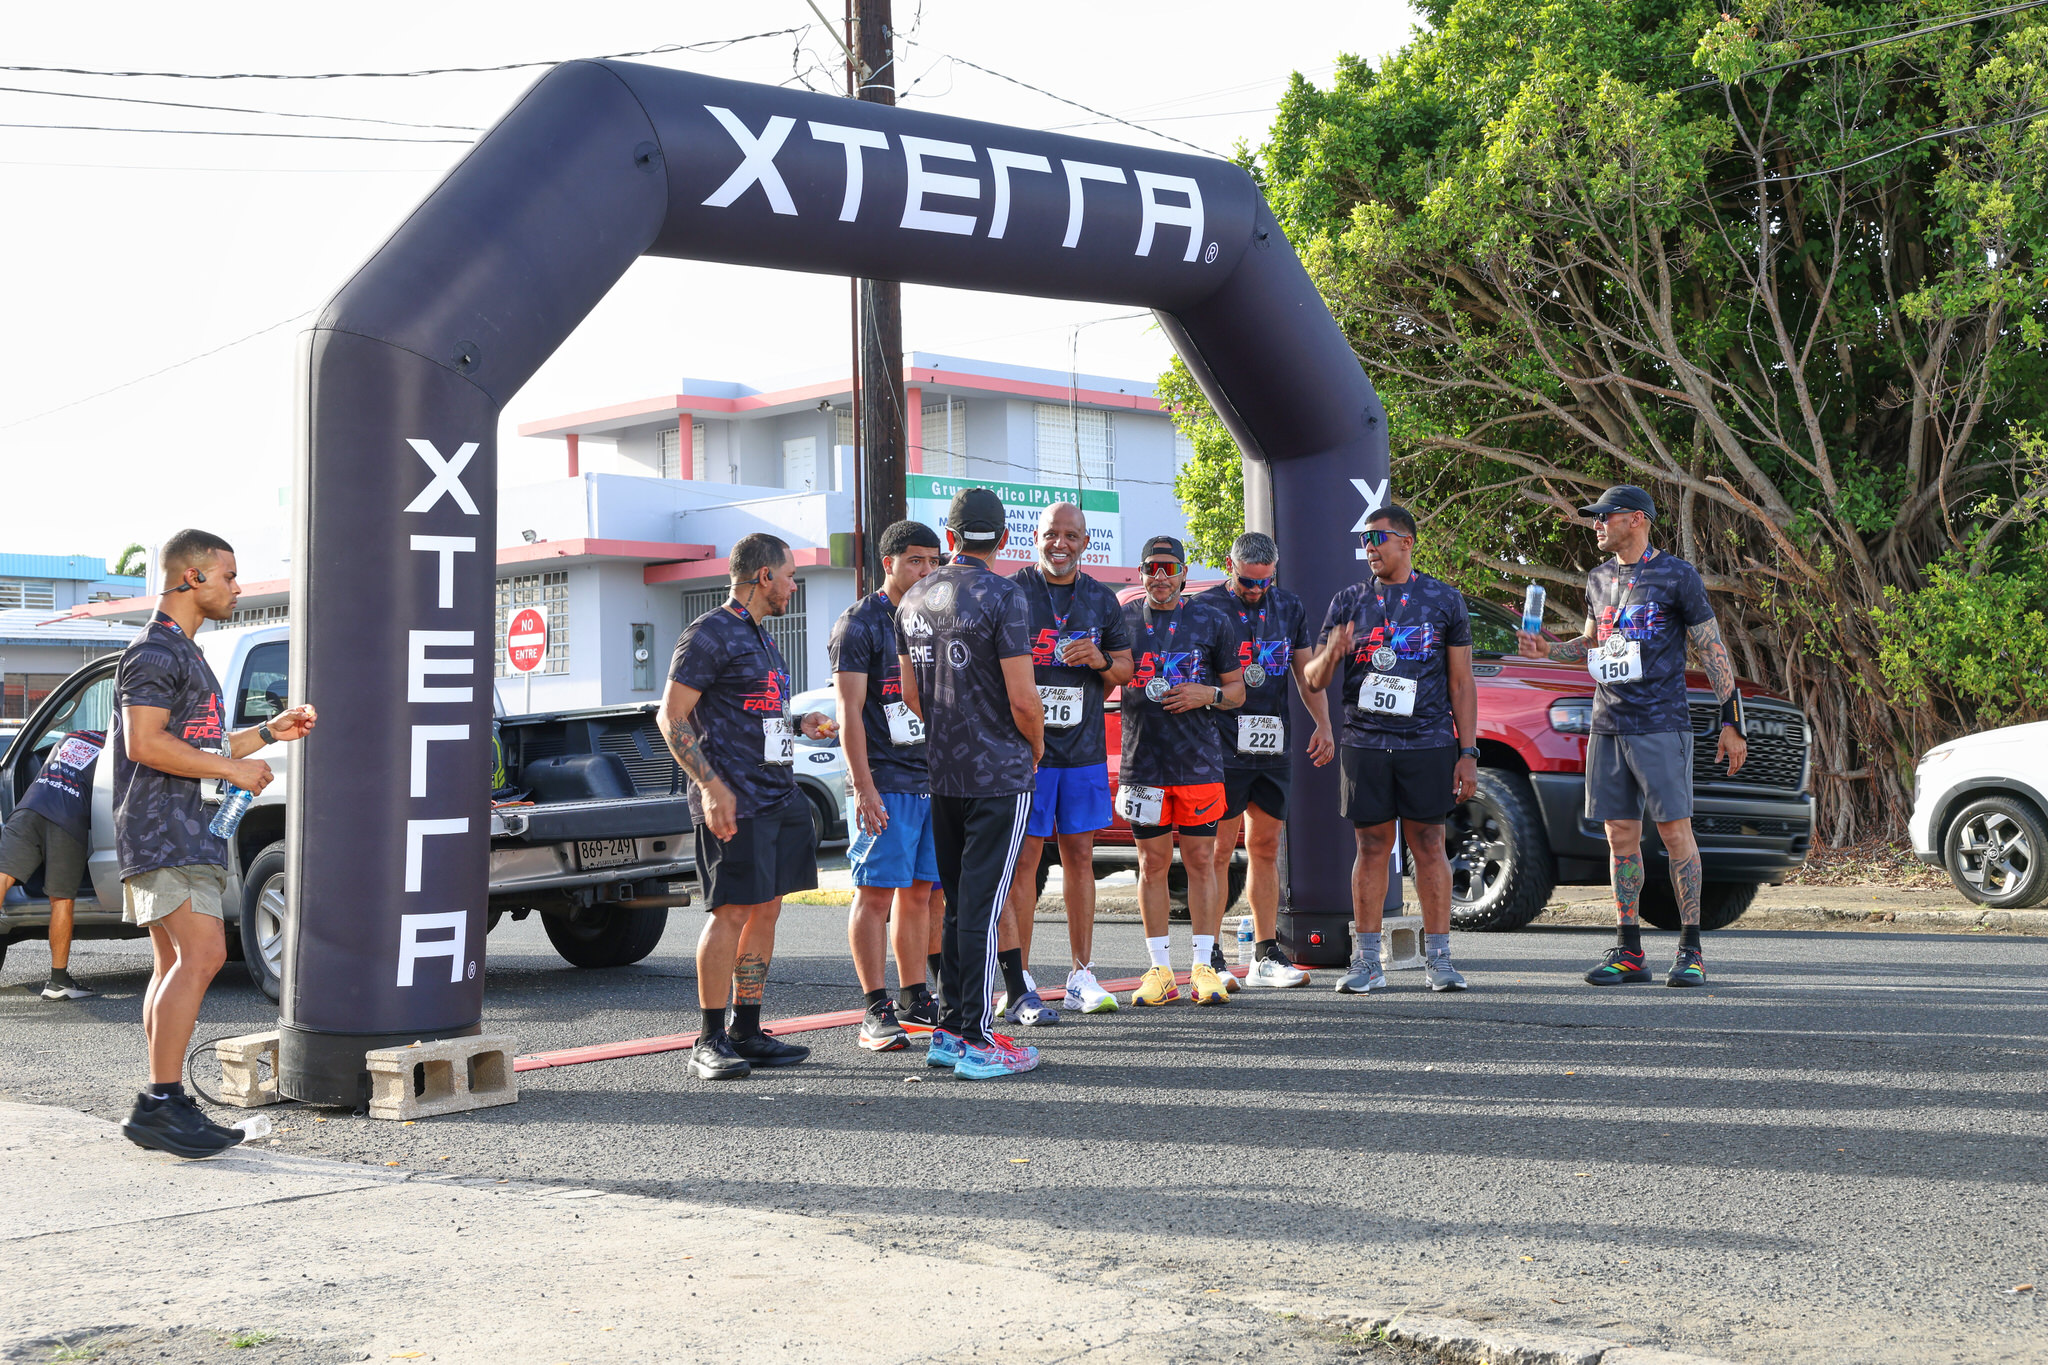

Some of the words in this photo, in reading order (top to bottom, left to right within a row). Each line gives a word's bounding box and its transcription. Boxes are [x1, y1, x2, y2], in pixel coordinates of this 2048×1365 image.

[931, 481, 964, 496] Gru
[977, 485, 1026, 503] dico
[1029, 489, 1050, 504] IPA
[1054, 491, 1078, 506] 513
[1004, 509, 1025, 520] LAN
[1085, 528, 1114, 539] NTIVA
[1005, 536, 1034, 547] LTOS
[1086, 541, 1111, 551] OGIA
[1082, 553, 1110, 564] -9371
[521, 618, 534, 632] NO
[1364, 626, 1421, 652] 5K
[515, 648, 538, 660] ENTRE
[1032, 655, 1053, 666] DE
[1237, 641, 1283, 666] 5K
[1135, 651, 1191, 677] 5K
[1599, 661, 1630, 680] 150
[1379, 676, 1400, 685] FADE
[1389, 683, 1406, 691] RUN
[881, 683, 902, 695] FA
[743, 699, 782, 711] FADE
[1374, 691, 1397, 710] 50
[1043, 704, 1071, 721] 216
[183, 725, 222, 739] FADE
[1746, 719, 1785, 737] AM
[1249, 732, 1277, 748] 222
[813, 753, 830, 762] 744
[1124, 799, 1142, 819] 51
[581, 838, 631, 859] 869-249
